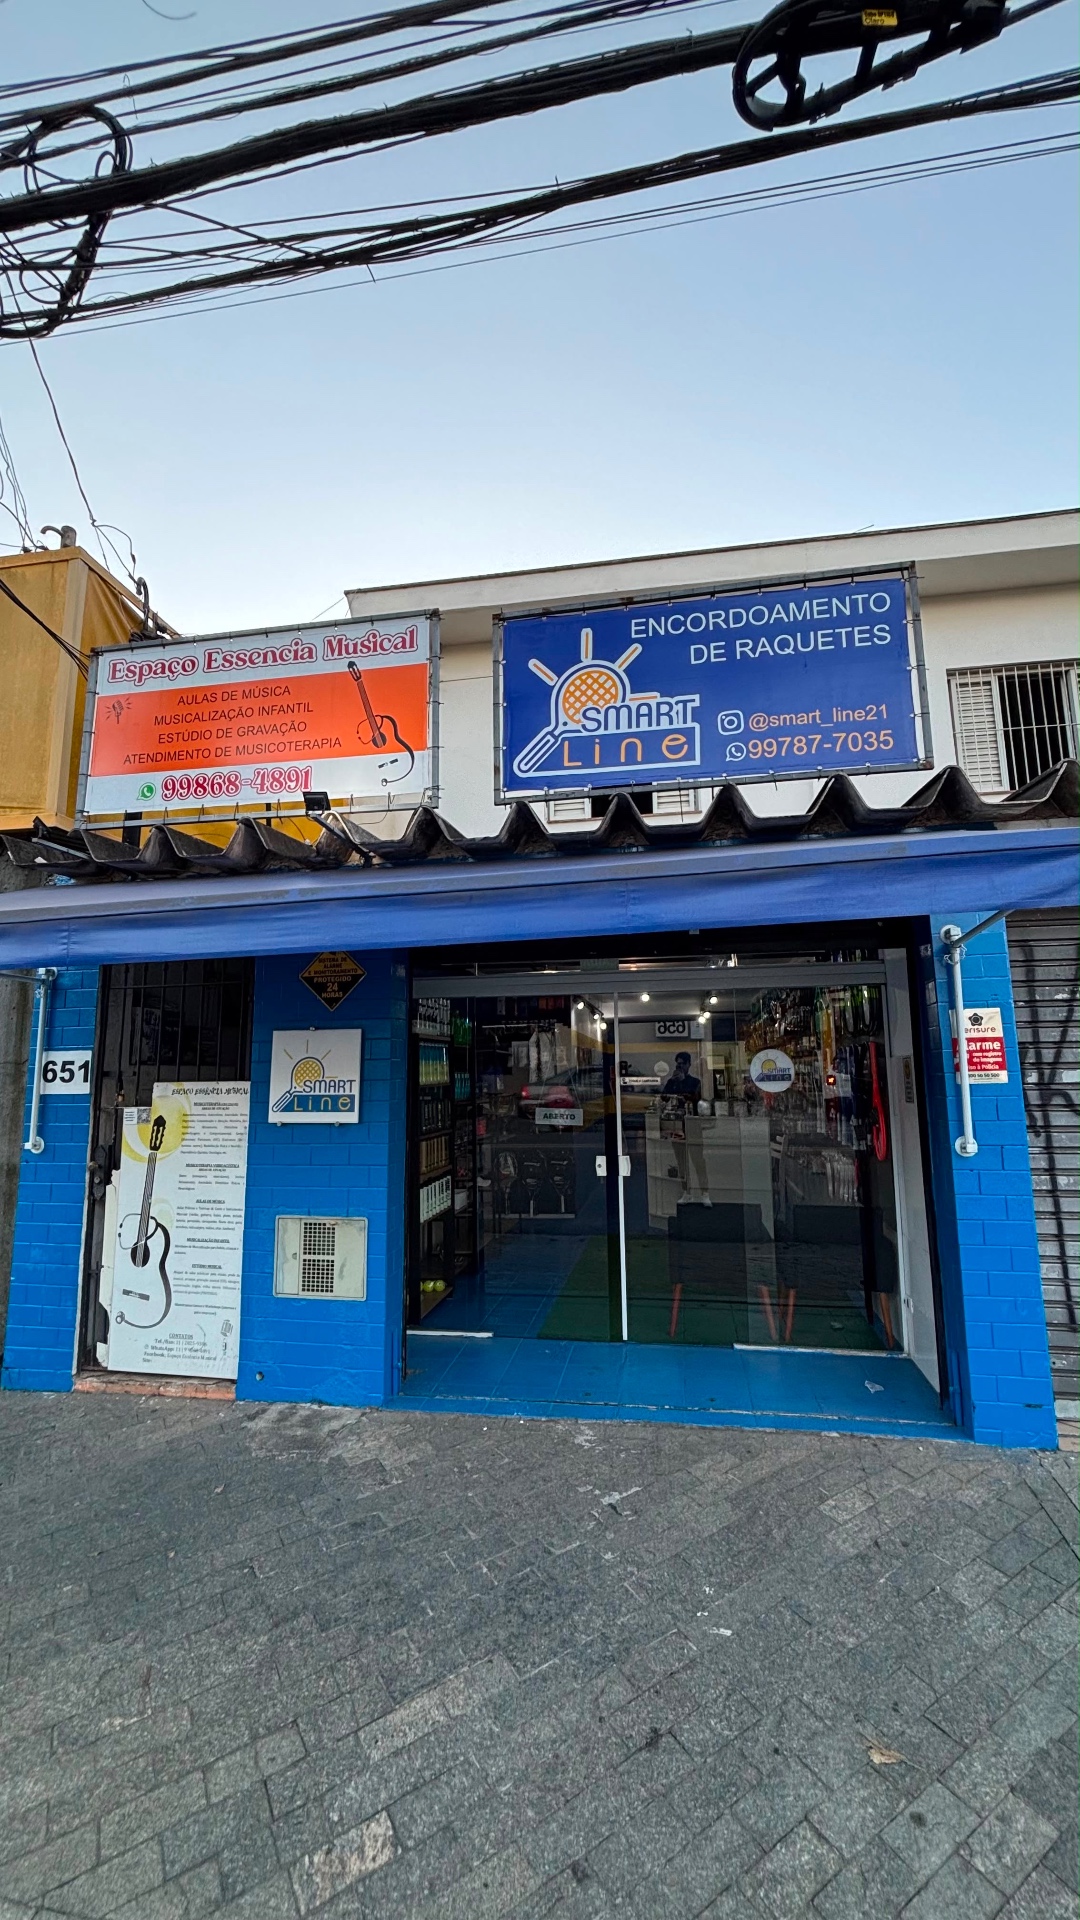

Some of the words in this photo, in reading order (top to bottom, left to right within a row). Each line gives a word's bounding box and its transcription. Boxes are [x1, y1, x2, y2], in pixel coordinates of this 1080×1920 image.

[630, 592, 891, 639] ENCORDOAMENTO
[108, 656, 199, 686] Espaço
[203, 638, 317, 673] Essencia
[323, 625, 418, 661] Musical
[689, 641, 727, 664] DE
[736, 624, 891, 660] RAQUETES
[177, 692, 217, 706] AULAS
[221, 690, 238, 702] DE
[241, 685, 291, 700] MÚSICA
[154, 706, 254, 726] MUSICALIZAÇÃO
[258, 702, 314, 717] INFANTIL
[580, 697, 697, 733] SMART
[748, 703, 888, 732] @smart_line21
[158, 729, 213, 744] ESTÚDIO
[216, 728, 233, 739] DE
[236, 720, 307, 738] GRAVAÇÃO
[123, 748, 211, 765] ATENDIMENTO
[214, 746, 232, 758] DE
[235, 737, 342, 756] MUSICOTERAPIA
[748, 730, 894, 759] 99787-7035
[162, 766, 312, 801] 99868-4891
[313, 975, 352, 983] PROTEGIDO
[327, 982, 339, 992] 24
[957, 1039, 1002, 1050] larme
[42, 1060, 90, 1083] 651
[303, 1079, 356, 1093] SMART
[542, 1112, 576, 1121] ABERTO
